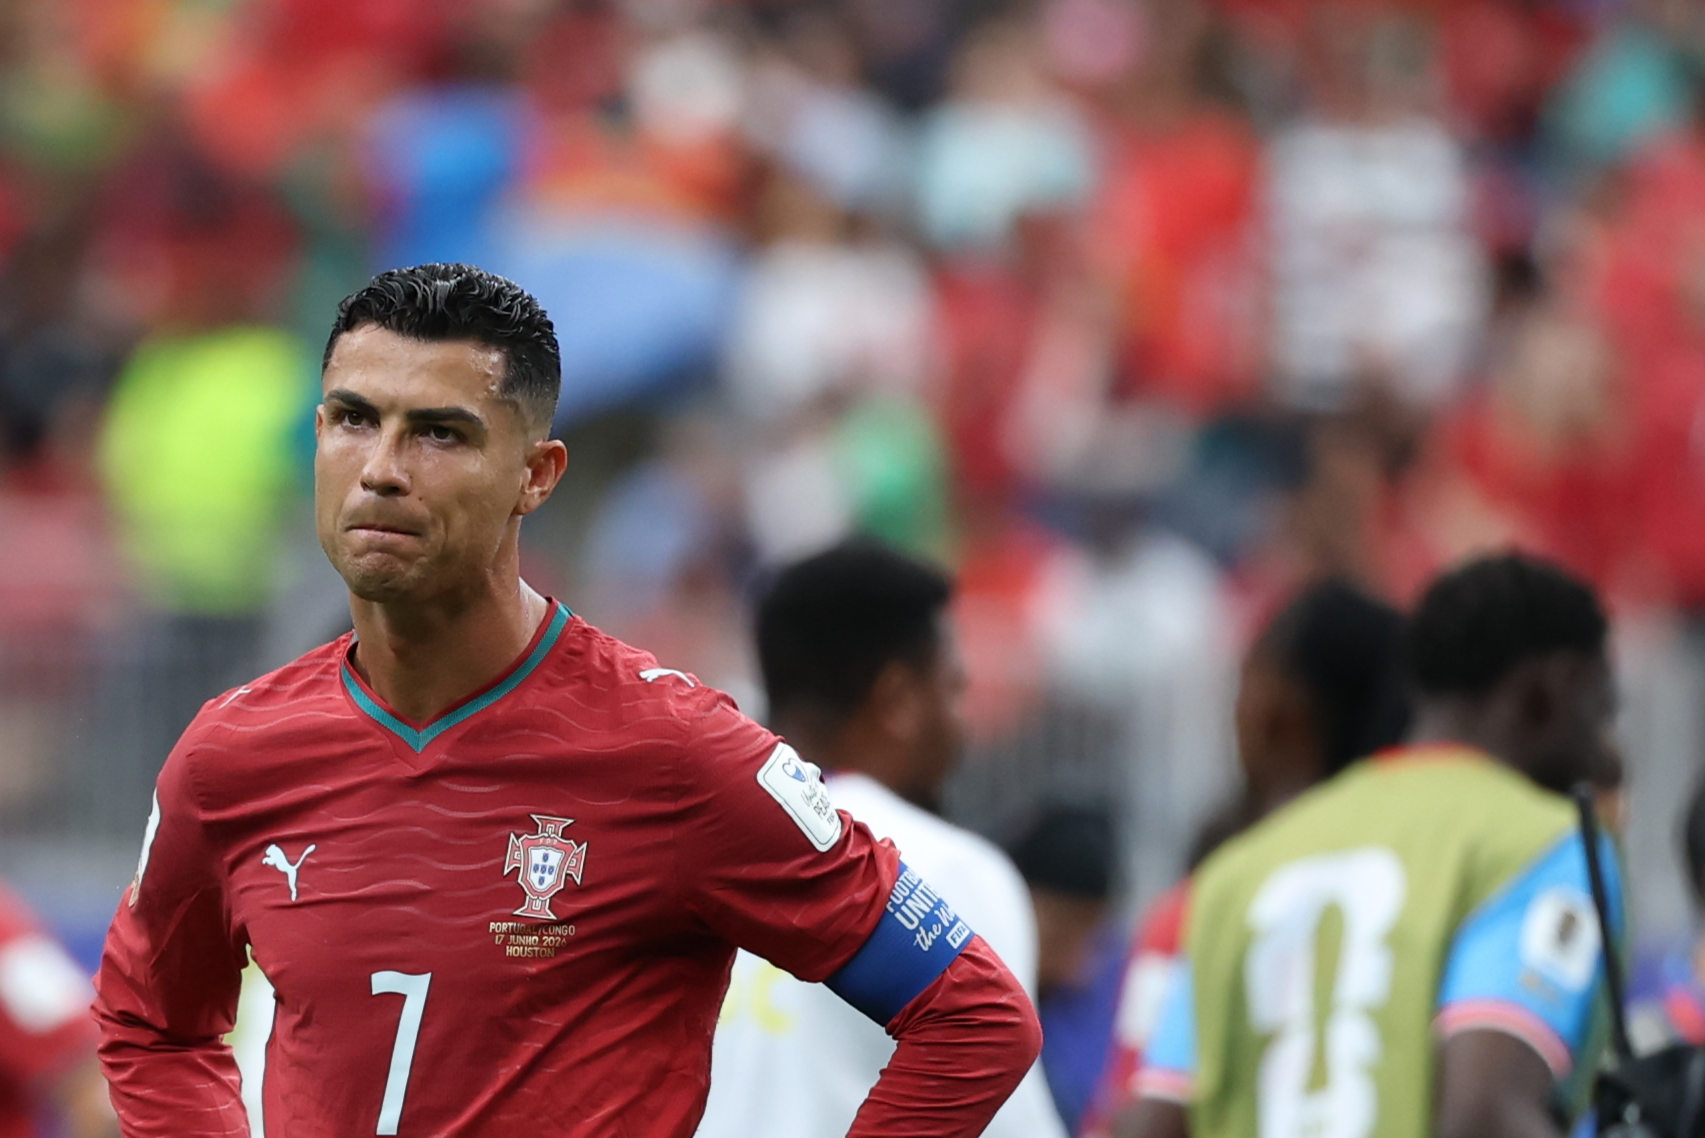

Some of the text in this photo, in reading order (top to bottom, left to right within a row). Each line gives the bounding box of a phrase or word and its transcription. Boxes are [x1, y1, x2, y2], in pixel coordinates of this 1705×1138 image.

[495, 934, 567, 947] 17 JUNHO 2026
[913, 923, 942, 951] the
[949, 924, 968, 945] FIFA
[506, 945, 555, 958] HOUSTON
[371, 970, 433, 1136] 7
